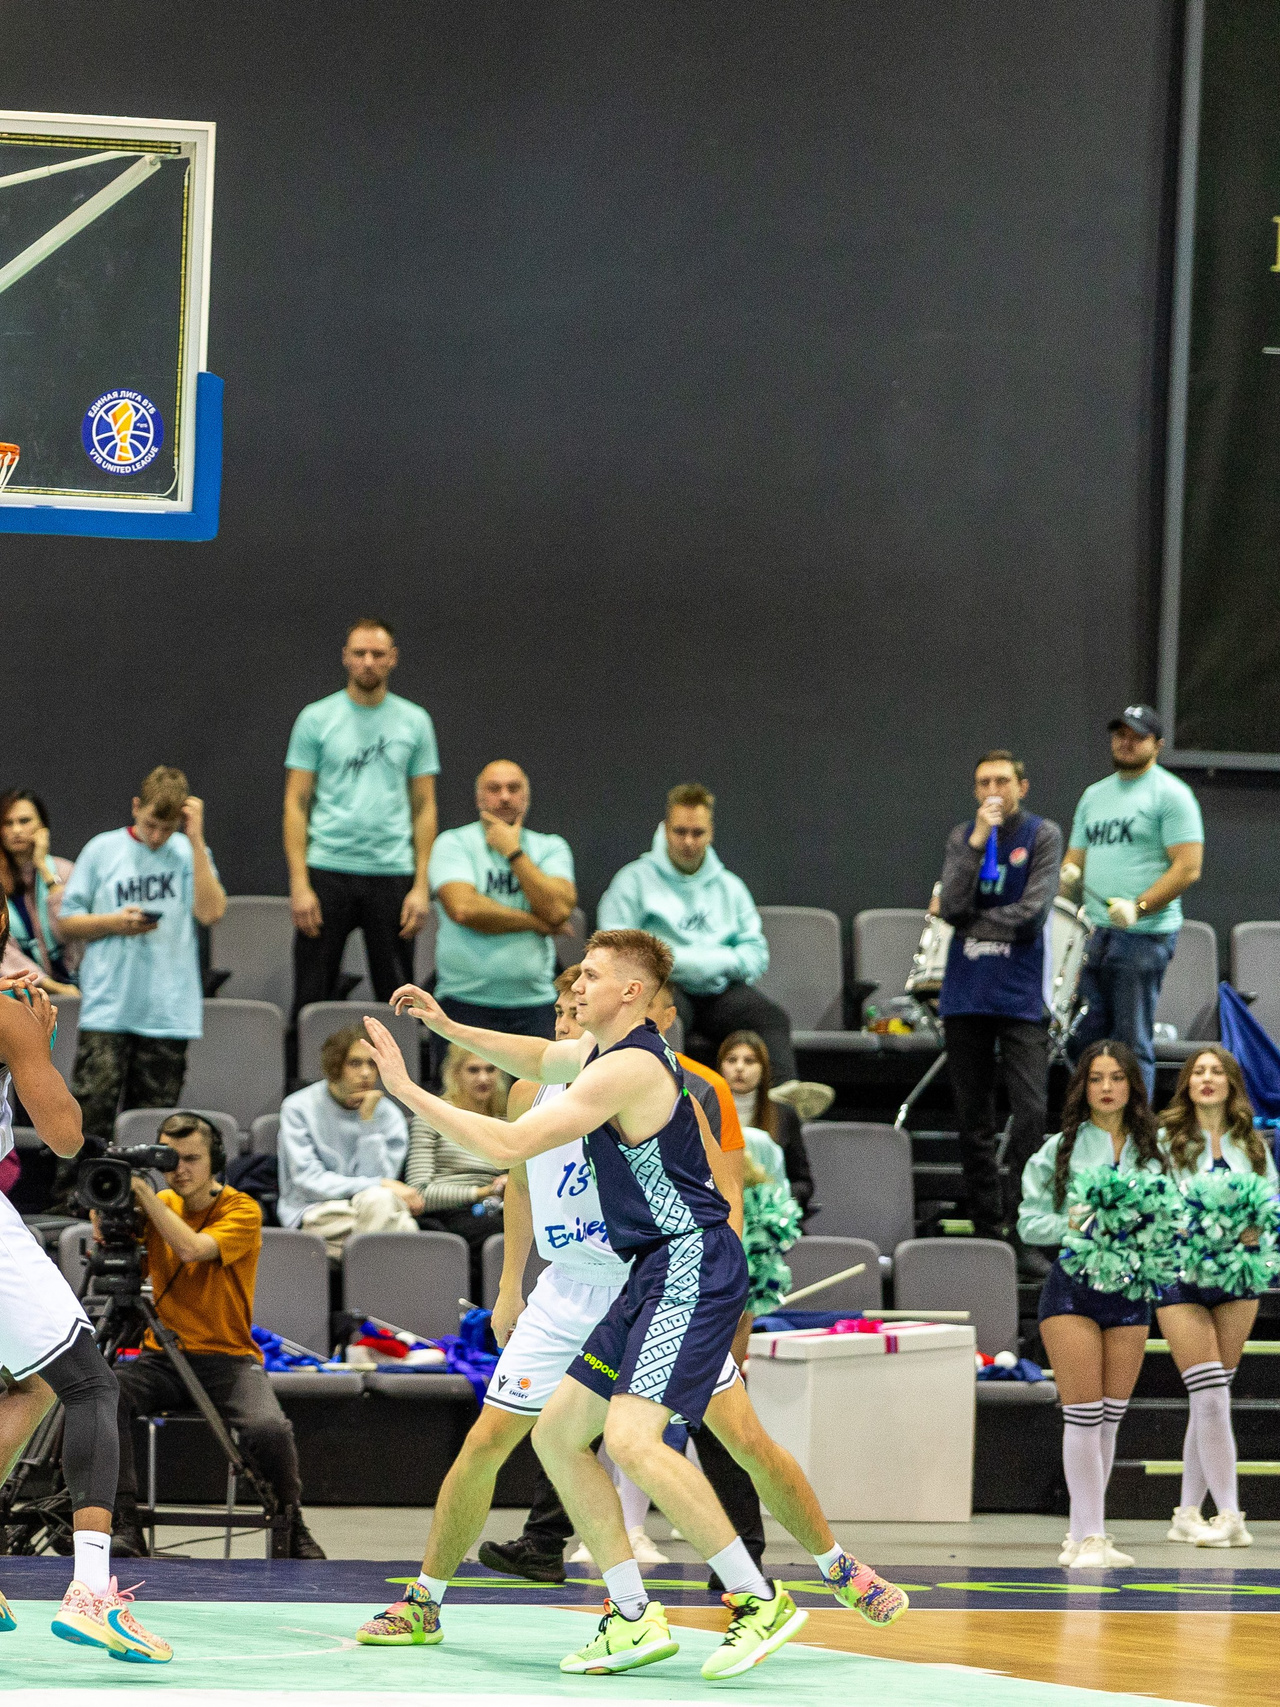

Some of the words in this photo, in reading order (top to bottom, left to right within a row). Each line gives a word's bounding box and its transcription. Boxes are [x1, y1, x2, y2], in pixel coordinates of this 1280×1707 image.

[87, 391, 119, 418] ЕДИНАЯ
[120, 391, 142, 402] ЛИГА
[141, 399, 156, 415] ВТБ
[89, 448, 102, 465] VTB
[101, 460, 131, 474] UNITED
[132, 445, 159, 472] LEAGUE
[557, 1161, 591, 1198] 13
